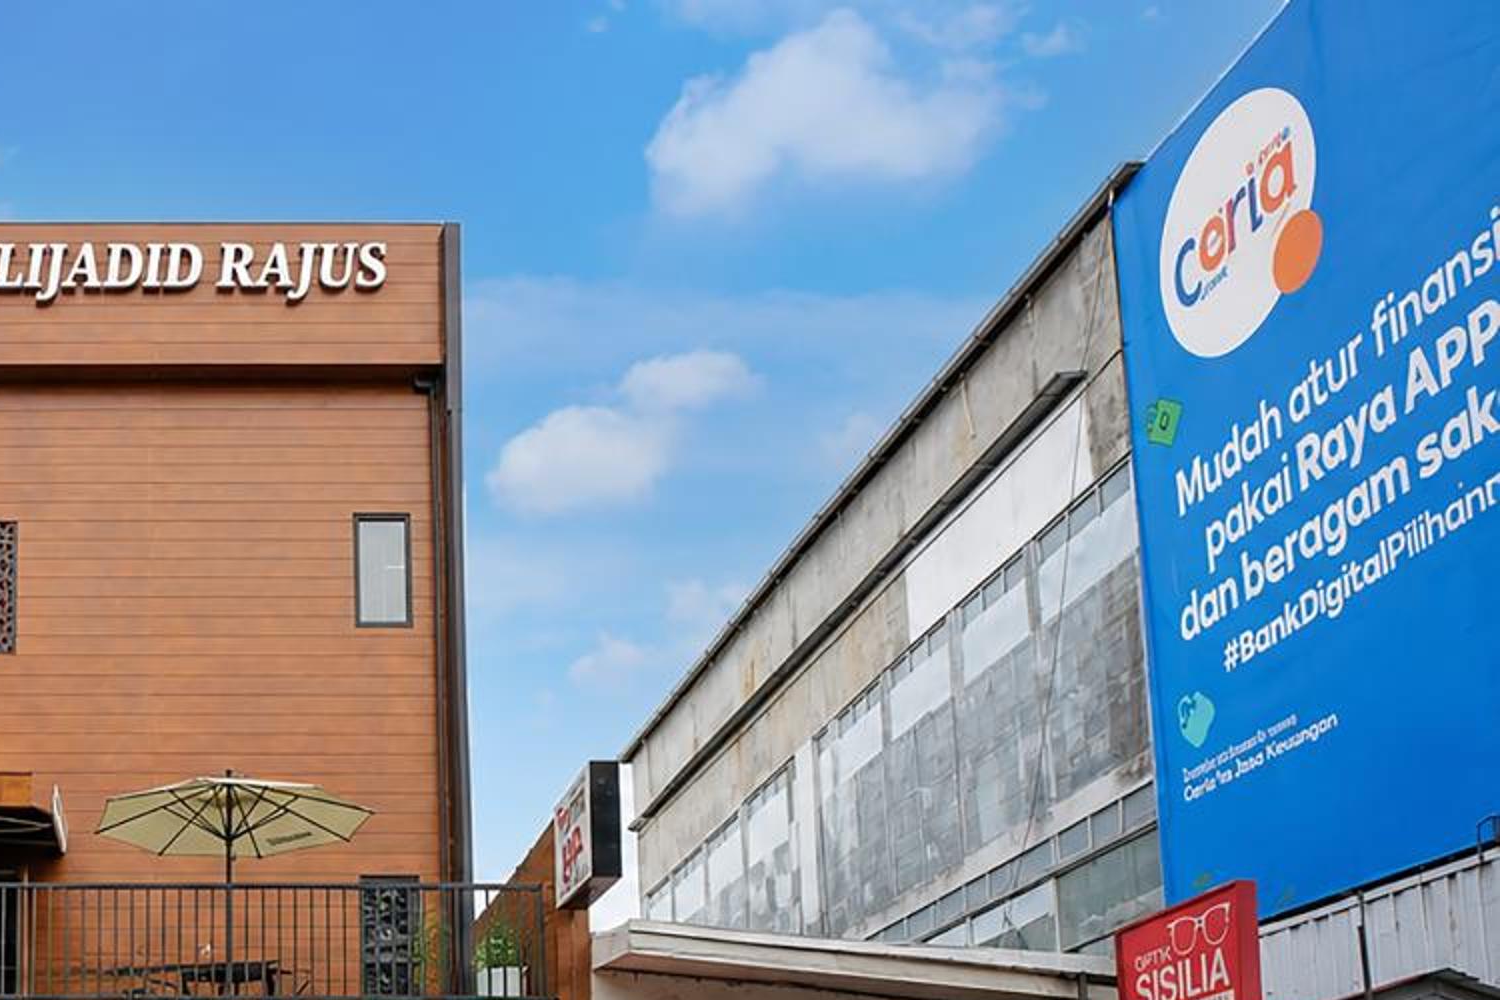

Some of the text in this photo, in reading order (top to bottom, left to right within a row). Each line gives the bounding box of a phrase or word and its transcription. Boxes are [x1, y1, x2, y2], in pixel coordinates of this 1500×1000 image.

[216, 242, 388, 300] RAJUS
[1174, 141, 1297, 307] Ceria
[1175, 399, 1281, 517] Mudah
[1288, 333, 1364, 424] atur
[1179, 385, 1500, 641] dan beragam sak
[1206, 299, 1500, 574] pakai Raya APP
